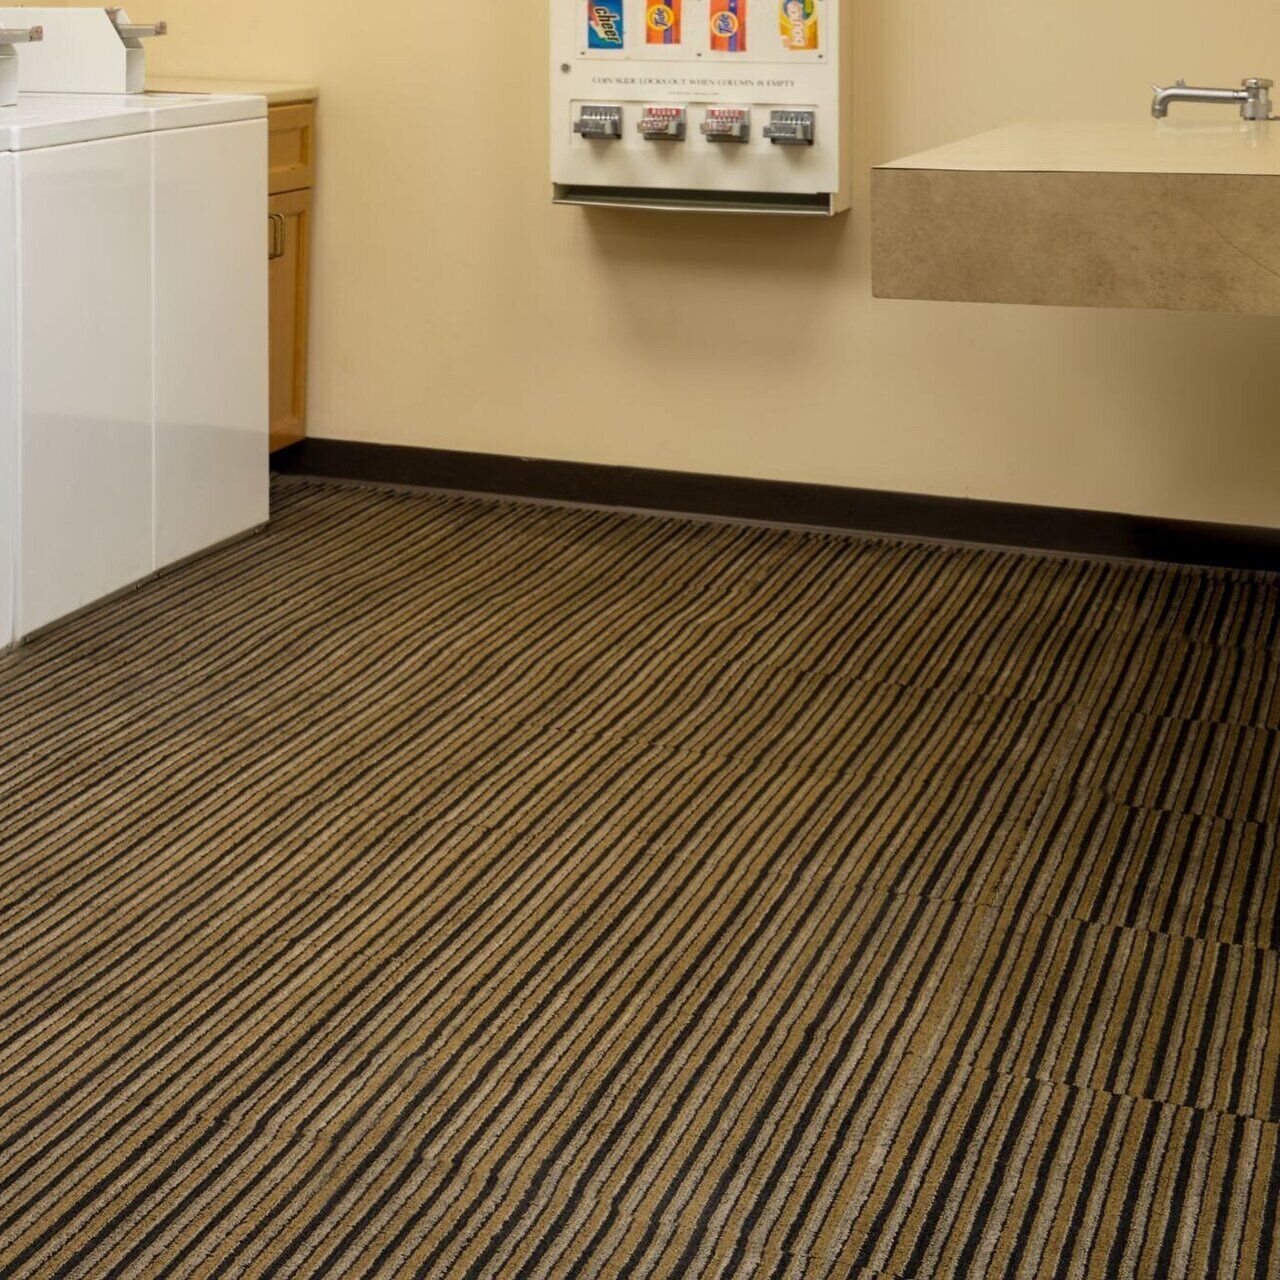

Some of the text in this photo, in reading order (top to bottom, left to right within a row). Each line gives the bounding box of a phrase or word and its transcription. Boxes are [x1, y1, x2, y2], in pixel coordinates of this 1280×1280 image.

[594, 7, 620, 43] cheer
[655, 7, 669, 27] Tide
[719, 13, 734, 34] Tide
[689, 78, 715, 86] WHEN
